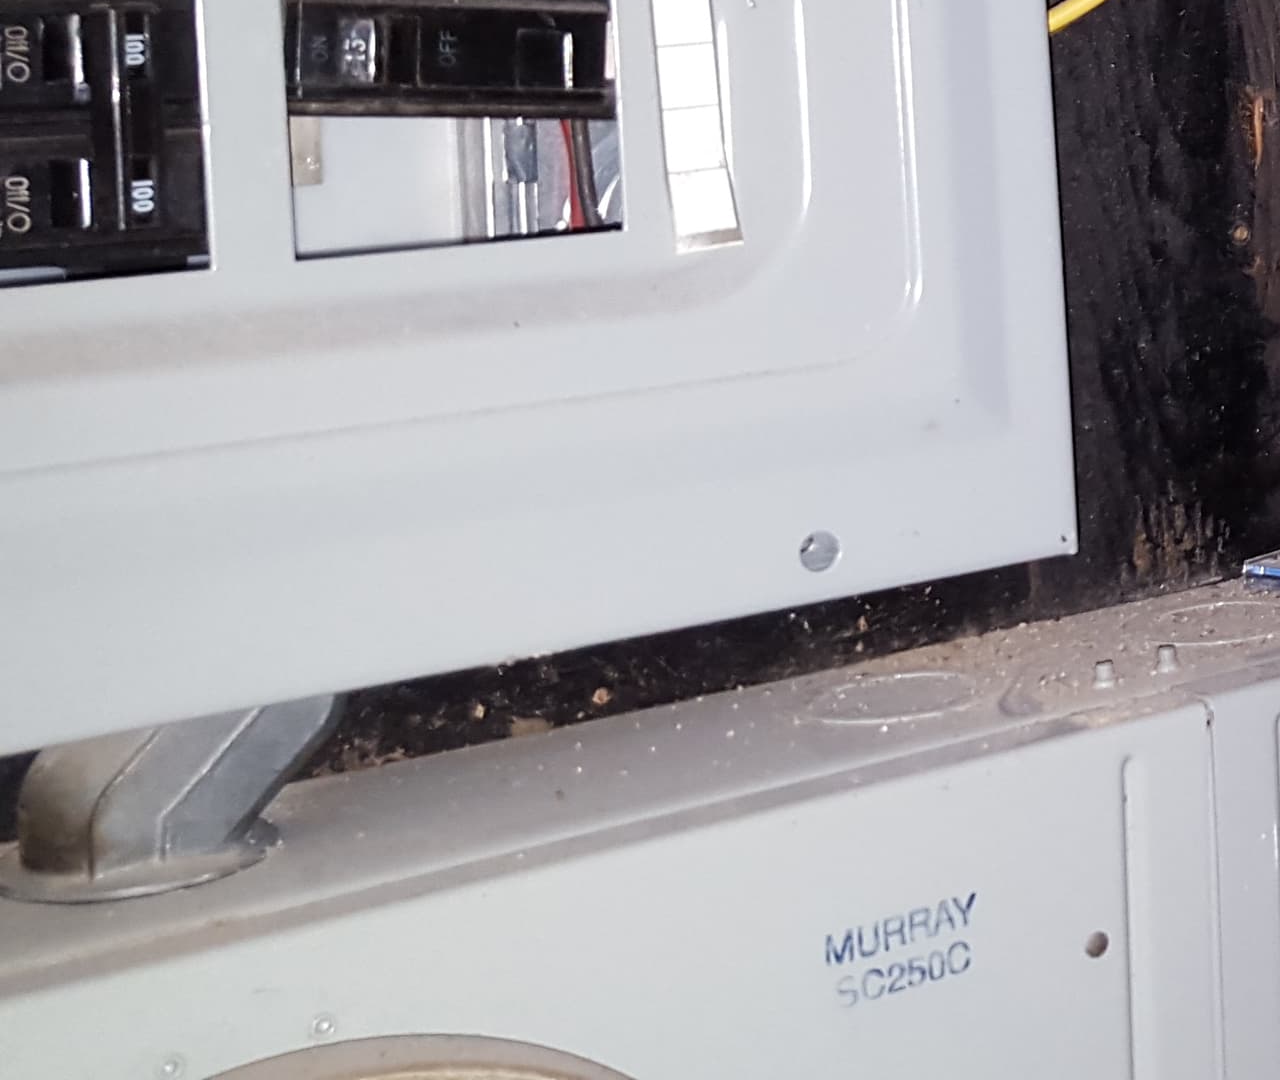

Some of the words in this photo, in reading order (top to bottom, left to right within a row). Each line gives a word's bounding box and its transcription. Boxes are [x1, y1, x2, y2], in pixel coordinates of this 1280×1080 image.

[125, 33, 146, 67] 100
[437, 29, 458, 69] OFF
[131, 180, 154, 214] 100
[825, 893, 976, 965] MURRAY
[837, 941, 971, 1008] SC250C
